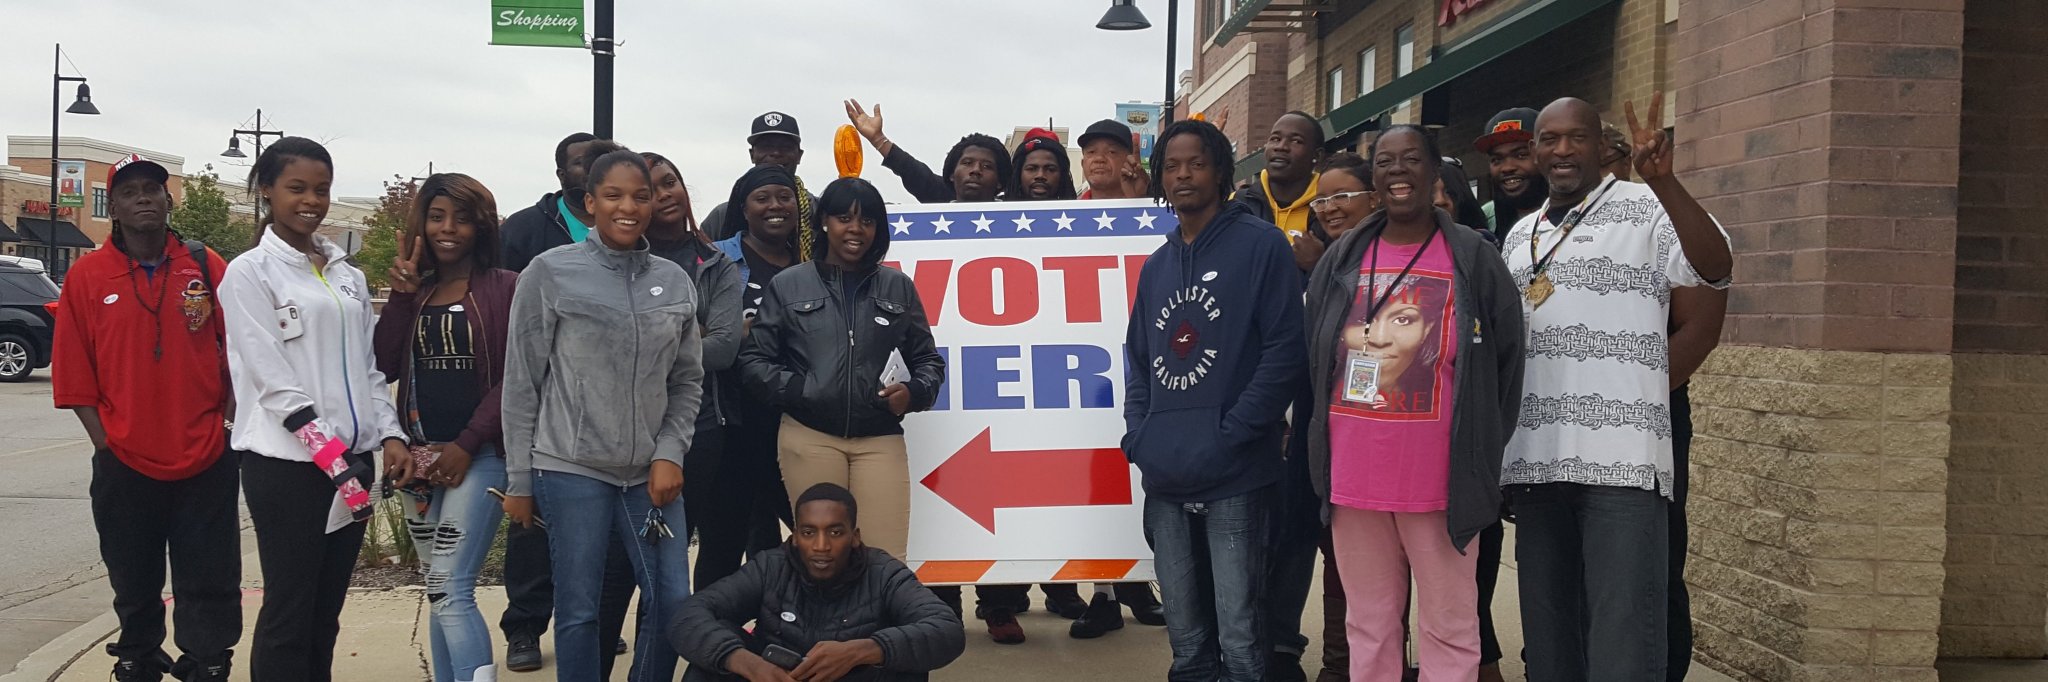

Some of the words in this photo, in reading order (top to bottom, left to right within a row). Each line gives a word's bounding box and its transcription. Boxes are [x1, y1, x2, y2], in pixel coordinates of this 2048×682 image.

[496, 9, 579, 32] Shopping
[881, 255, 1151, 327] VOT
[1155, 285, 1221, 331] HOLLISTER
[926, 343, 1131, 411] ER
[1153, 348, 1218, 391] CALIFORNIA
